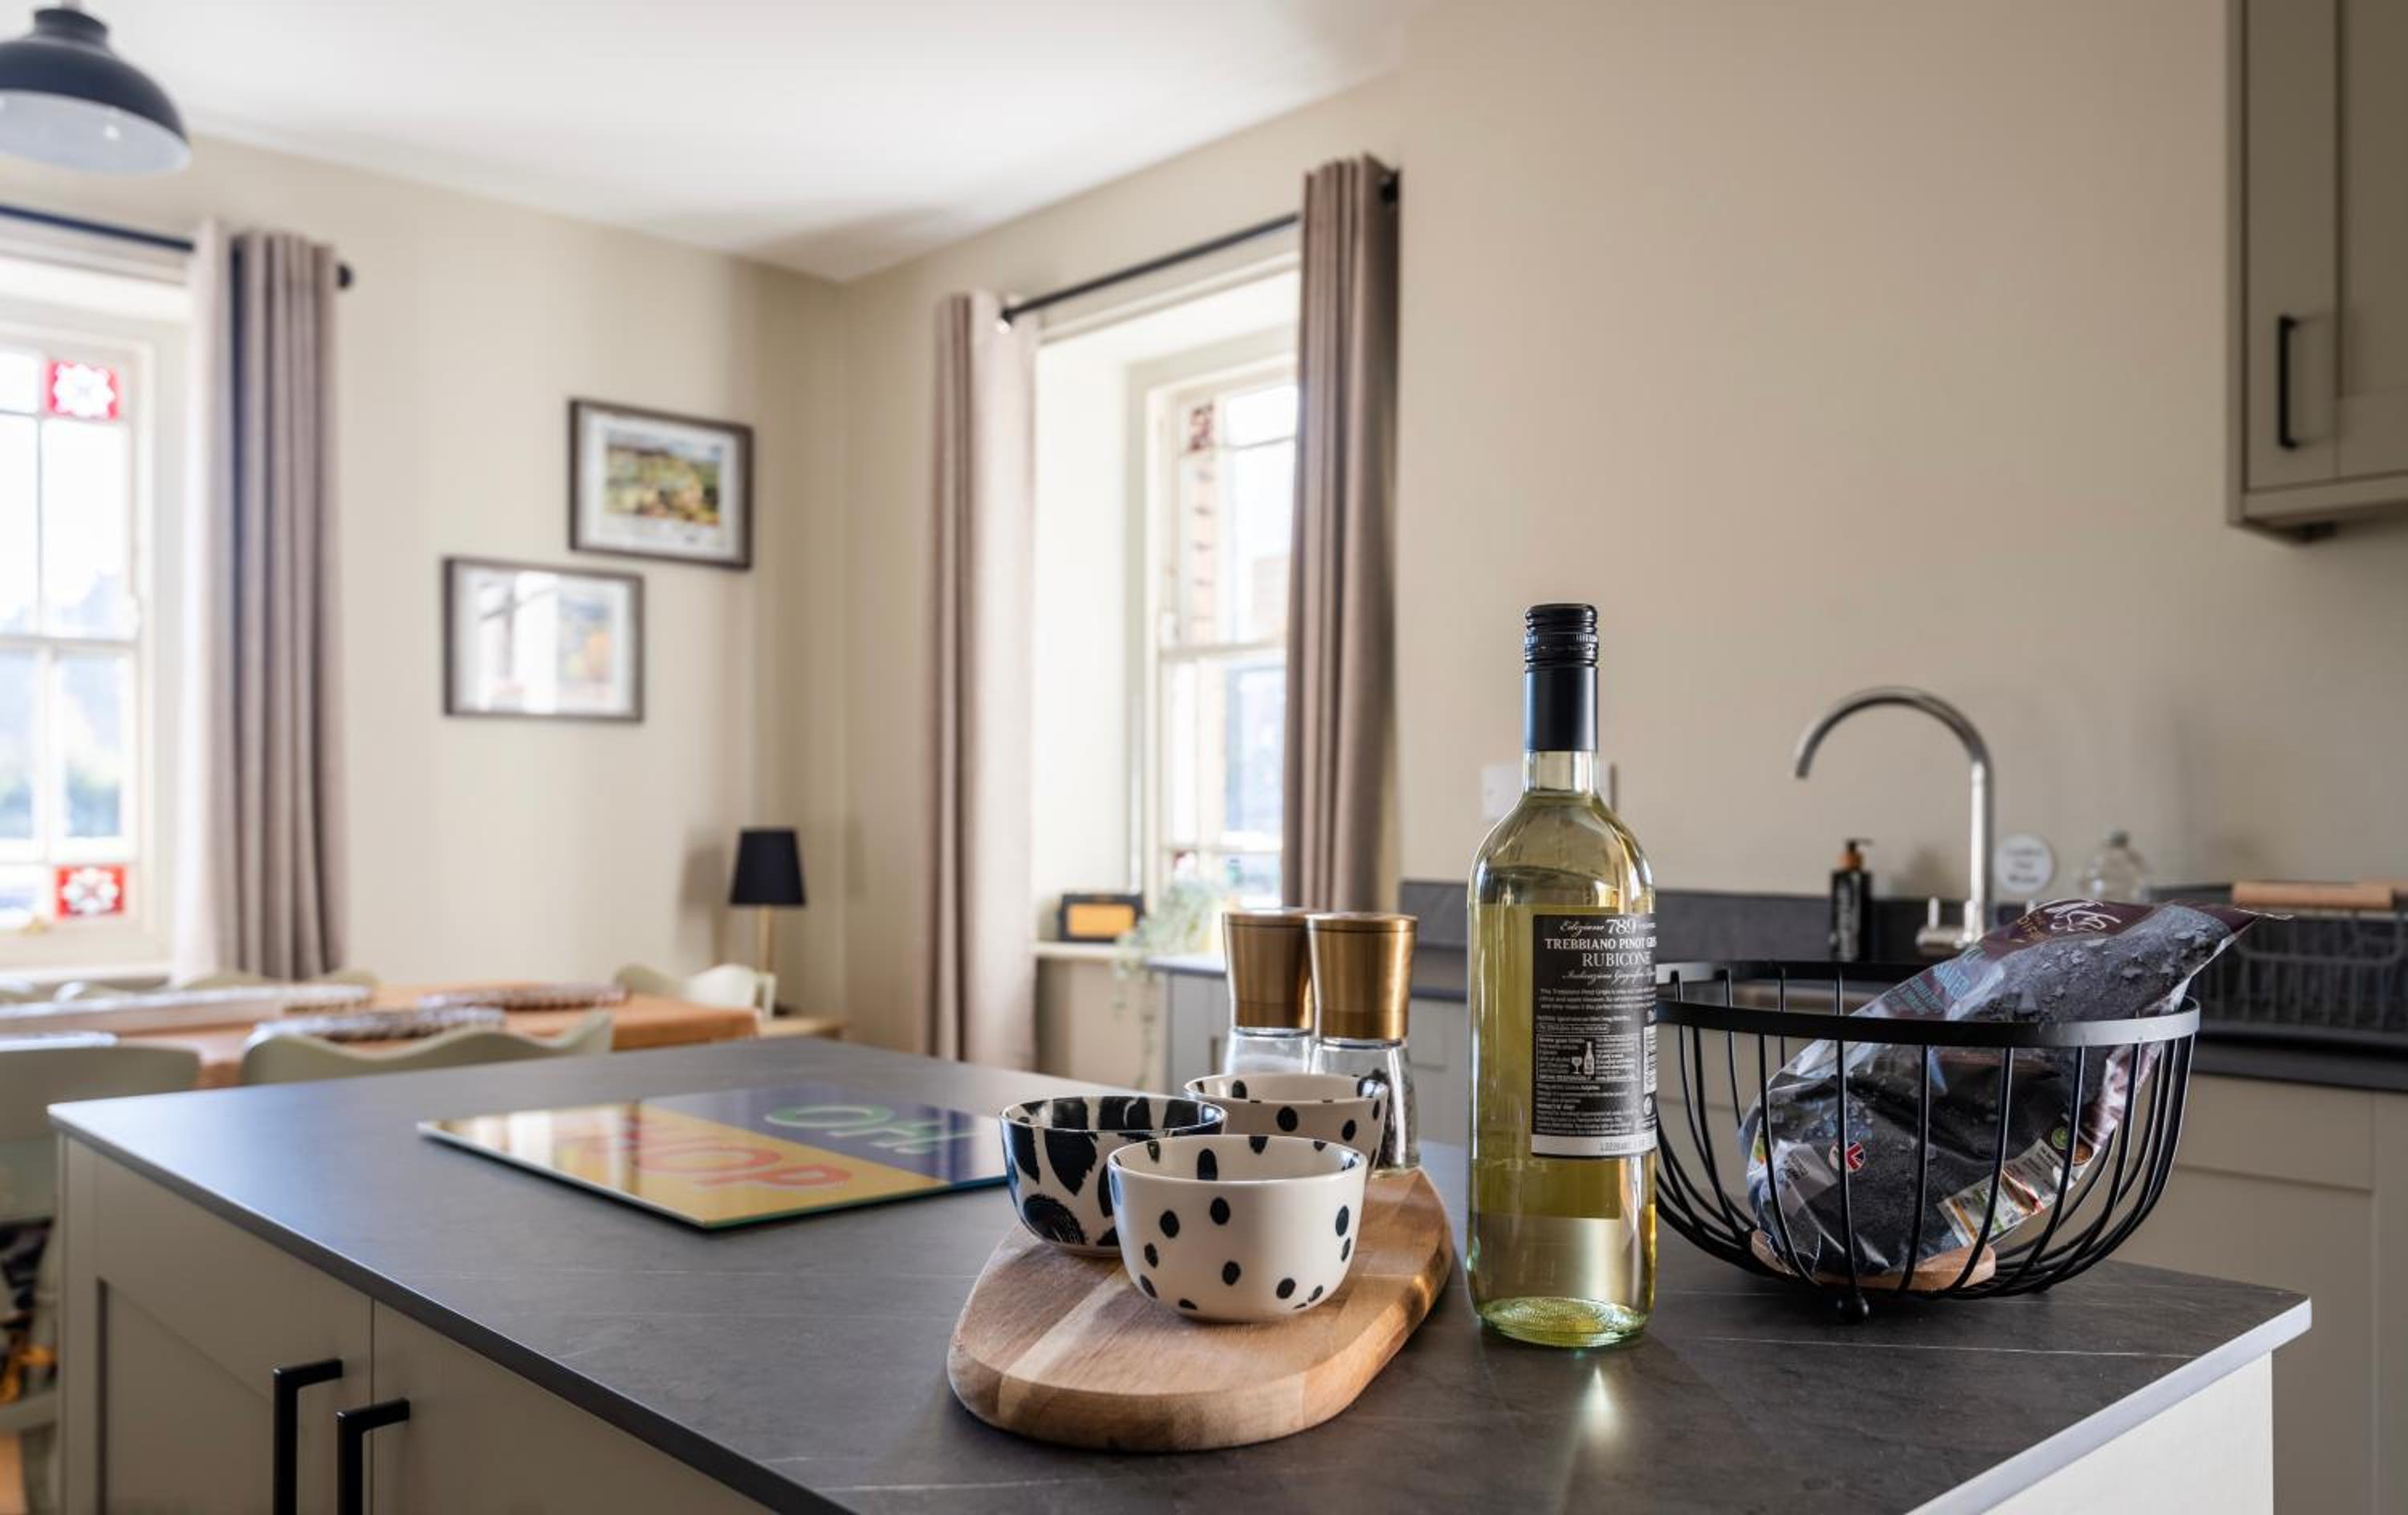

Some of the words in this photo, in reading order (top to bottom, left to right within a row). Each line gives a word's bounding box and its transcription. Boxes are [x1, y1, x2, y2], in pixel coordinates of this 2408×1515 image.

[1605, 918, 1637, 935] 789
[1544, 938, 1616, 950] TREBBIANO
[1619, 937, 1645, 949] PINOT
[1582, 951, 1651, 968] RUBICONE
